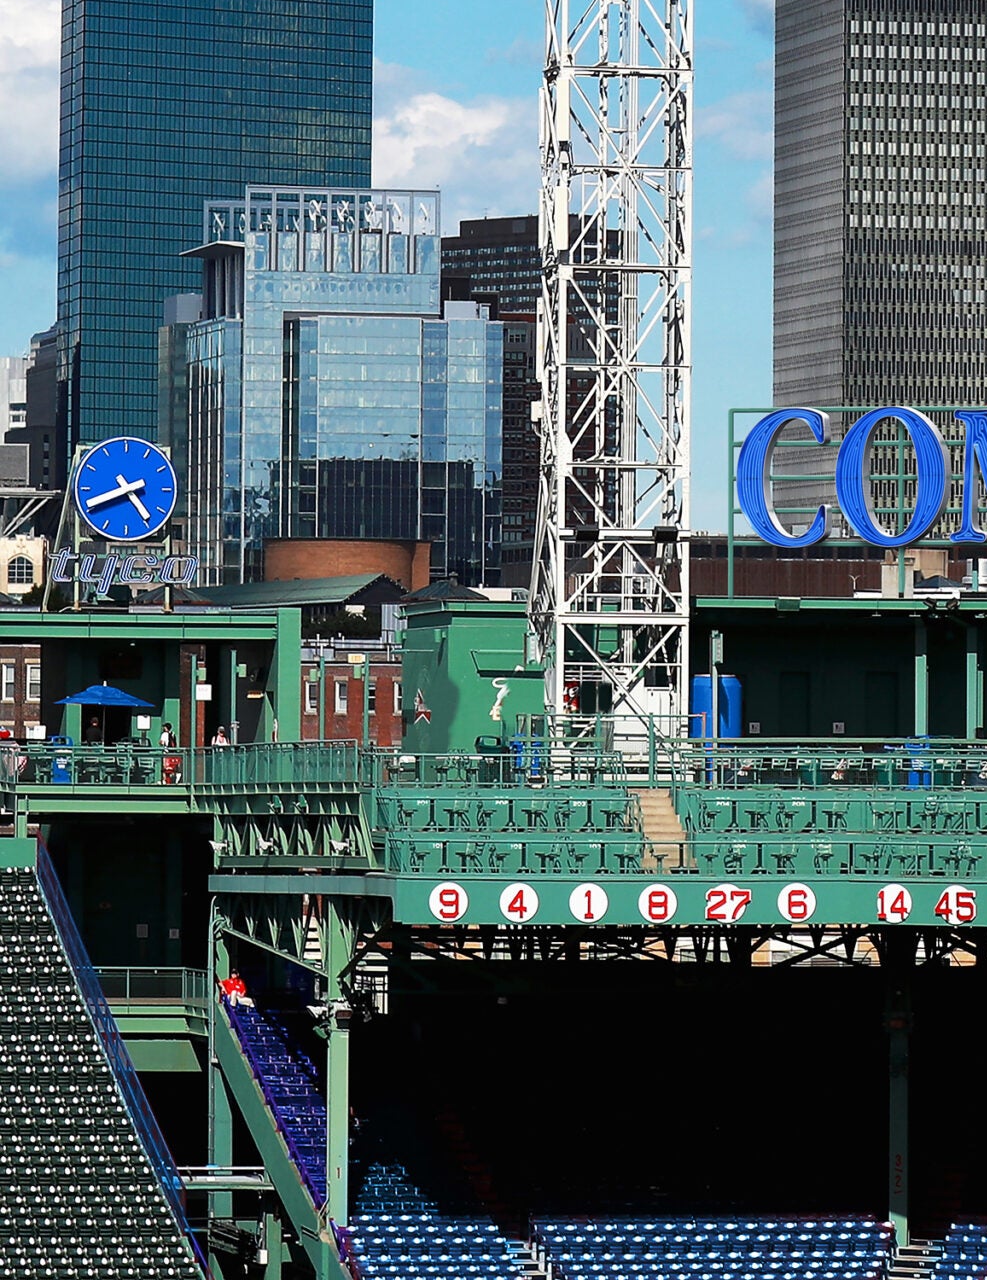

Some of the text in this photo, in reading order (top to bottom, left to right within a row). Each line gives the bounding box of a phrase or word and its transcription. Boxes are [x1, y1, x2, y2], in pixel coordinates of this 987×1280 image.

[49, 547, 200, 595] tyco
[439, 889, 460, 918] 9
[508, 890, 527, 918] 4
[584, 890, 594, 919] 1
[648, 891, 668, 919] 8
[706, 891, 750, 920] 27
[788, 890, 808, 919] 6
[877, 890, 909, 920] 14
[935, 892, 974, 921] 45
